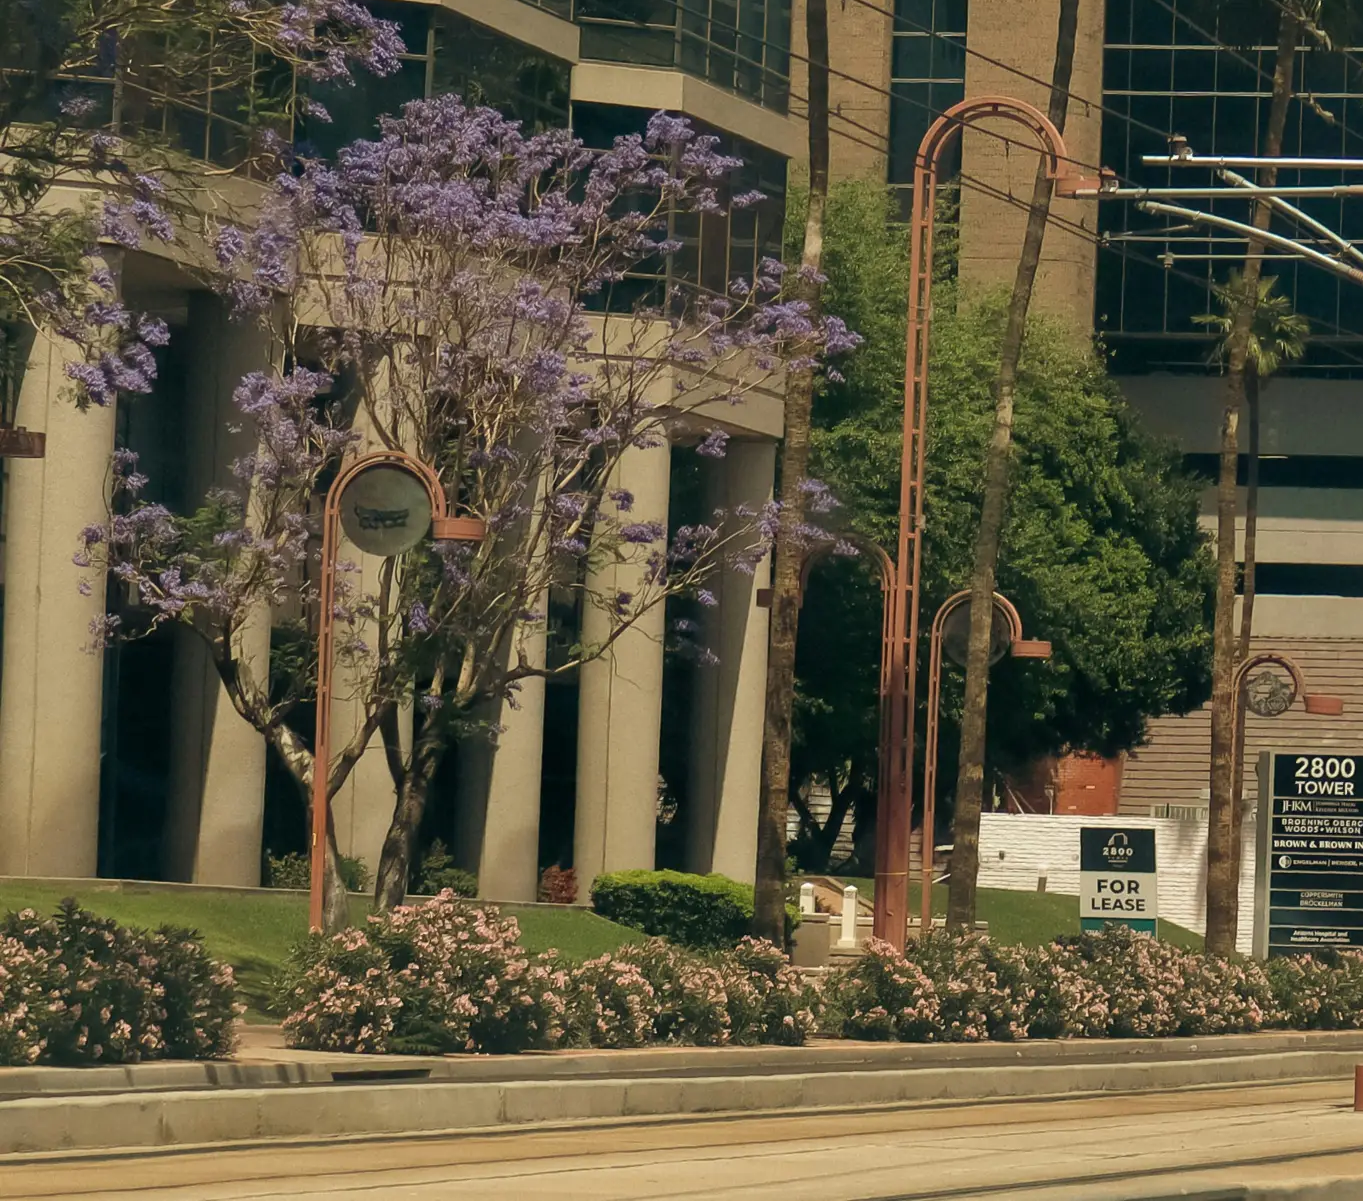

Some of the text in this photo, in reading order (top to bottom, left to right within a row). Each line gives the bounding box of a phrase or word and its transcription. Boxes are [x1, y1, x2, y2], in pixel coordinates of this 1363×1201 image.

[1295, 757, 1356, 779] 2800
[1295, 781, 1354, 796] TOWER
[1282, 800, 1312, 814] JHKM
[1281, 818, 1363, 828] BROENING OBERG
[1103, 847, 1133, 856] 2800
[1274, 839, 1308, 849] BROWN
[1309, 840, 1317, 849] &
[1319, 841, 1352, 850] BROWN
[1097, 879, 1140, 895] FOR
[1091, 897, 1146, 912] LEASE
